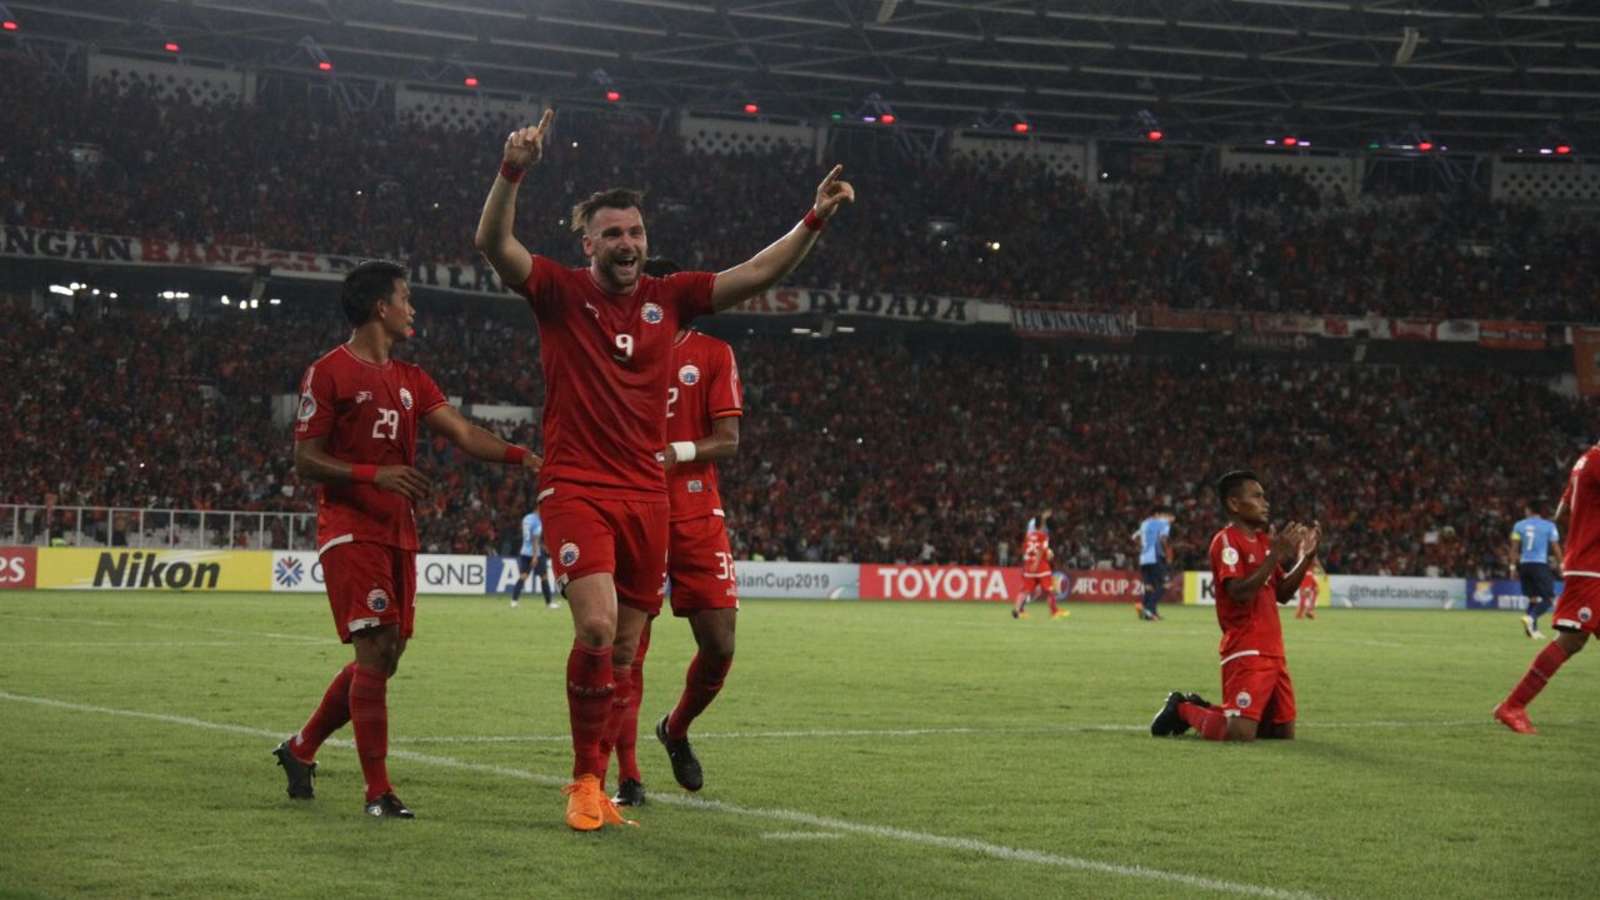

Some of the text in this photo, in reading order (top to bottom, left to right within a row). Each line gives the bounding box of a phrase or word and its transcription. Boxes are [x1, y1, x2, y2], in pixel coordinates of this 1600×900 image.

[614, 333, 634, 362] 9
[665, 387, 679, 418] 2
[372, 407, 399, 440] 29
[93, 551, 221, 588] Nikon
[425, 562, 484, 585] QNB
[735, 572, 829, 592] sianCup2019
[877, 567, 1009, 599] TOYOTA
[1072, 577, 1098, 595] AFC
[1101, 577, 1130, 595] CUP
[1349, 583, 1449, 604] @theafcasiancup
